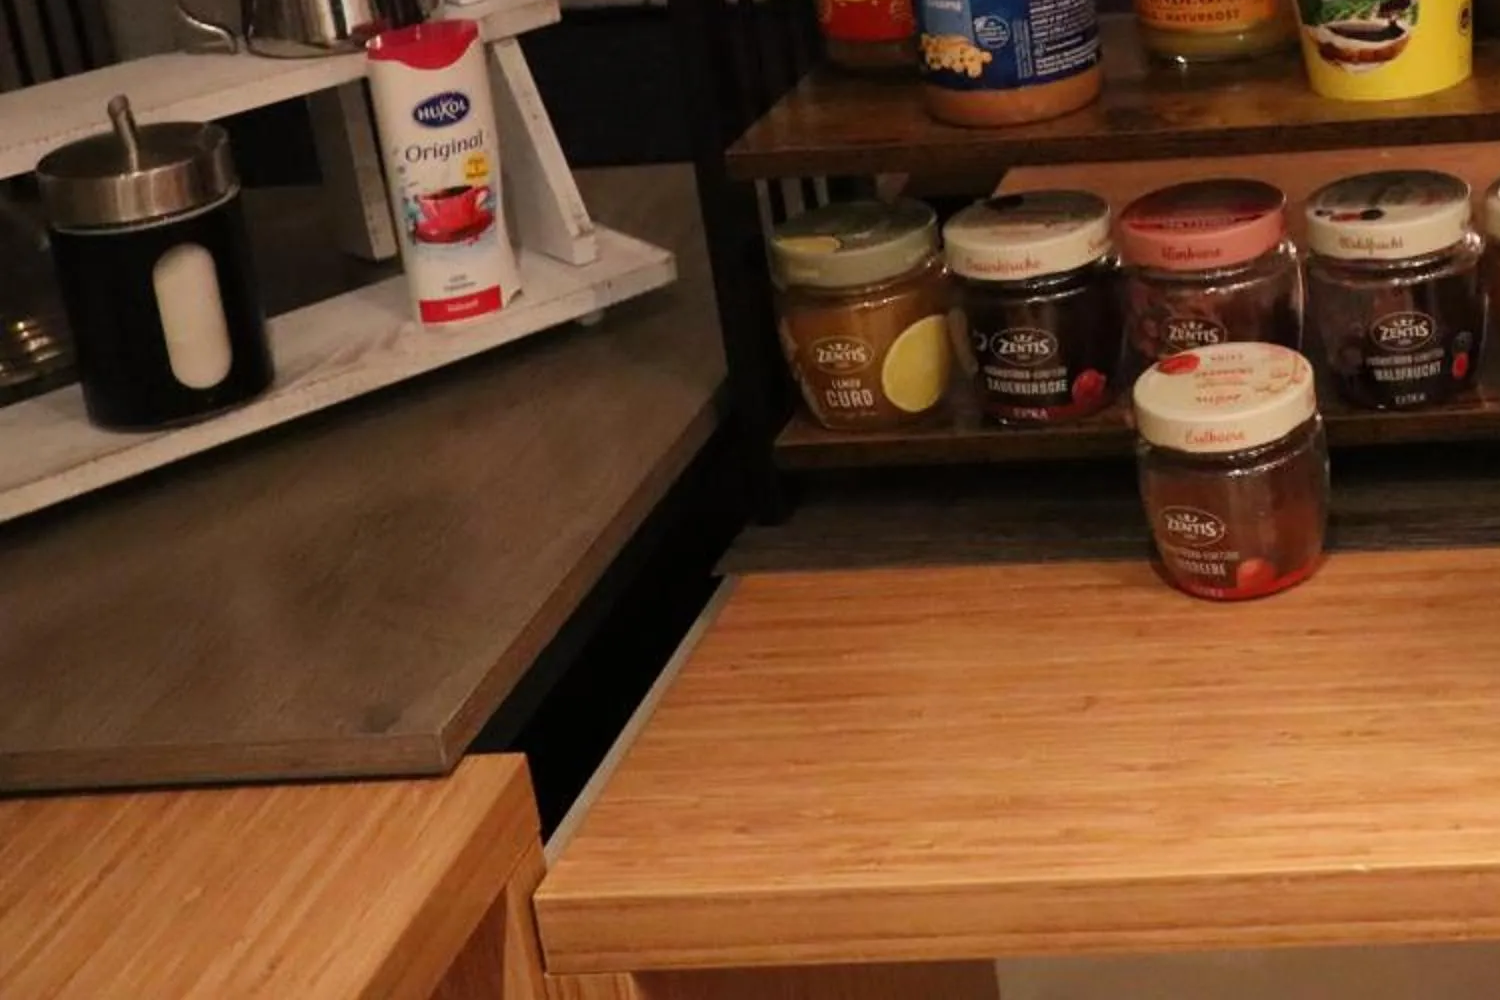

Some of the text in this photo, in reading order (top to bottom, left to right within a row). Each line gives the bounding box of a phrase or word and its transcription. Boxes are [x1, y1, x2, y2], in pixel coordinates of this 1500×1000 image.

[405, 128, 483, 163] Original
[1168, 325, 1219, 343] ZENTIS
[1379, 320, 1429, 341] ZENTIS
[816, 346, 866, 363] ZENTIS
[998, 338, 1049, 355] ZENTIS
[826, 389, 874, 409] CURD
[1165, 513, 1217, 537] ZENTIS
